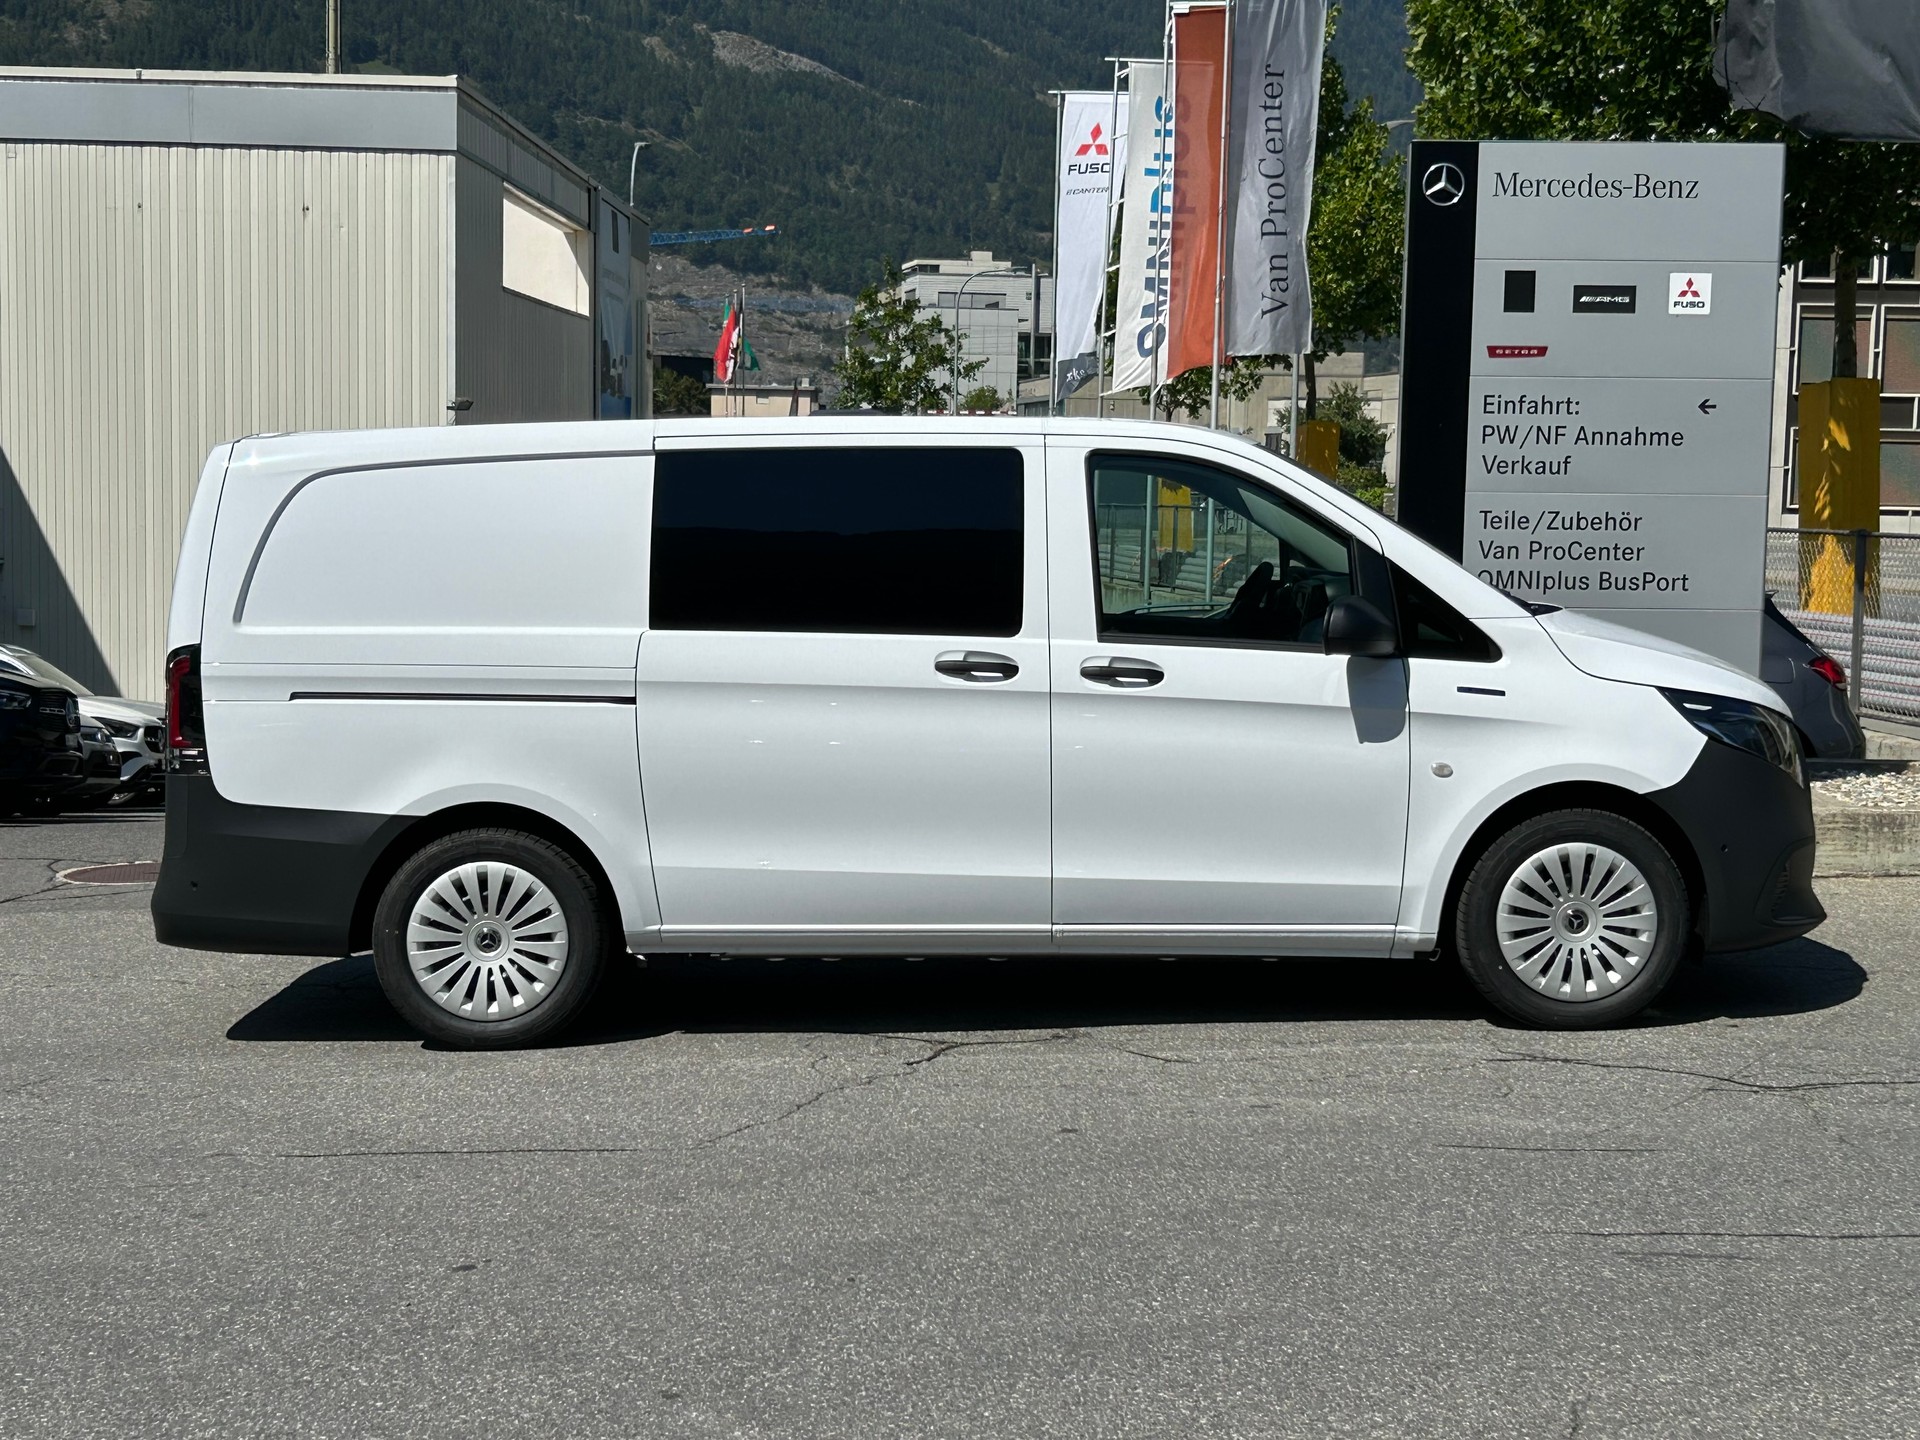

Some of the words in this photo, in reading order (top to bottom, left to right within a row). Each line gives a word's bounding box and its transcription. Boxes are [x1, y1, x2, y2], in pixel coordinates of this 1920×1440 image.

[1258, 64, 1287, 240] ProCenter
[1493, 172, 1699, 199] Mercedes-Benz
[1261, 252, 1288, 319] Van
[1673, 301, 1705, 309] FUSO
[1483, 394, 1580, 416] Einfahrt:
[1481, 424, 1567, 450] PW/NF
[1574, 426, 1684, 447] Annahme
[1482, 454, 1572, 476] Verkauf
[1479, 510, 1643, 535] Teile/Zubehör
[1478, 540, 1520, 560] Van
[1528, 540, 1645, 562] ProCenter
[1598, 571, 1689, 592] BusPort
